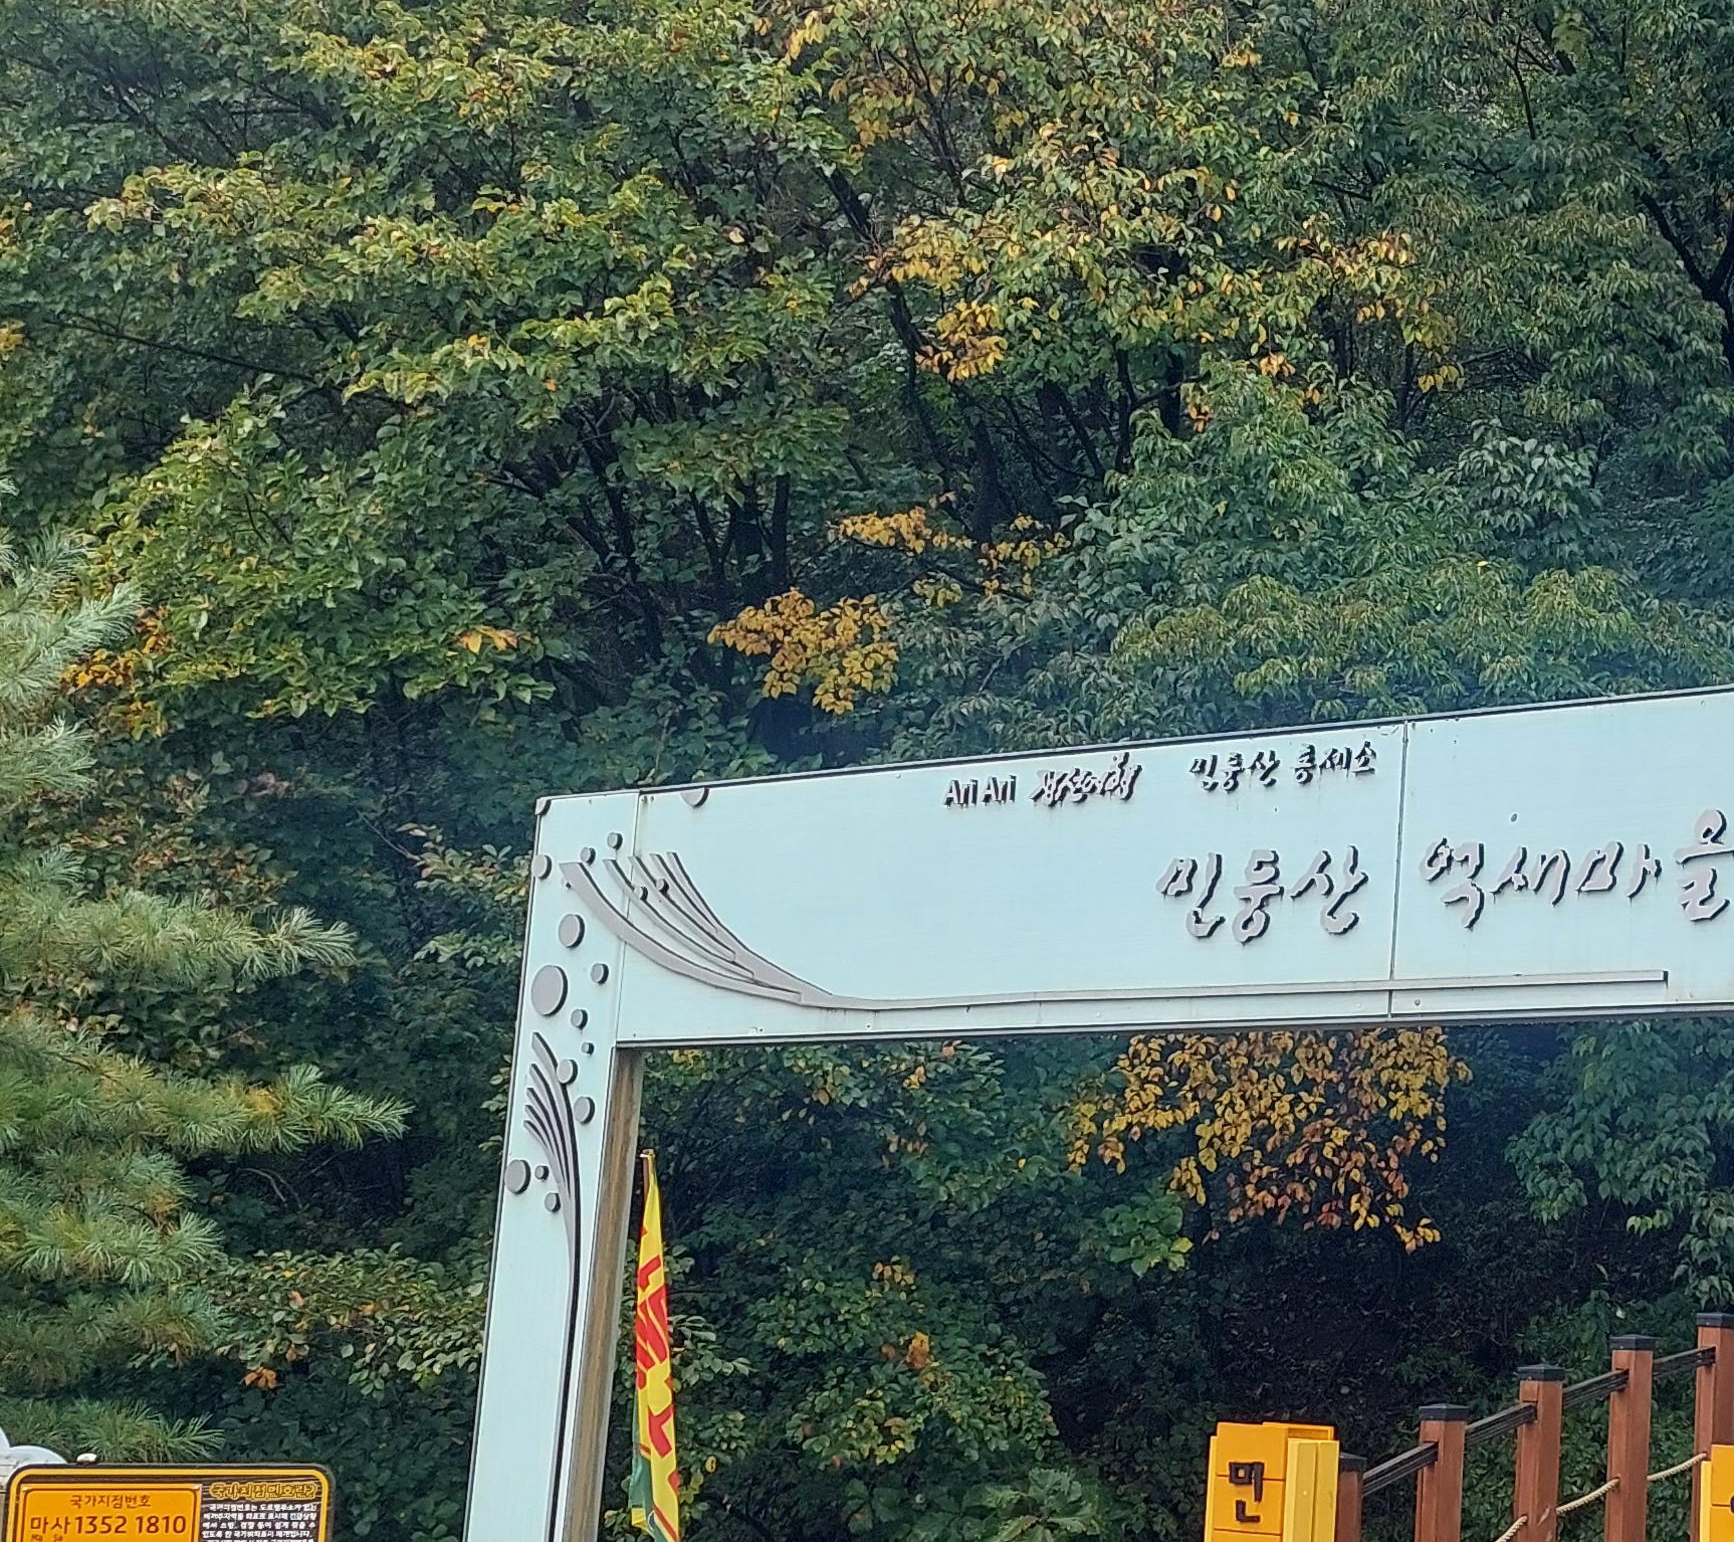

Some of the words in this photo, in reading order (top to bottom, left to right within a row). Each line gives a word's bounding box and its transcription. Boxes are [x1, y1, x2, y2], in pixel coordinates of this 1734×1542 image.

[944, 778, 978, 807] Ari
[982, 775, 1017, 804] Ari
[1156, 844, 1370, 946] 민둥산
[70, 1495, 151, 1509] 국가지점번호
[30, 1516, 71, 1535] 마사
[75, 1515, 127, 1534] 1352
[135, 1515, 187, 1534] 1810
